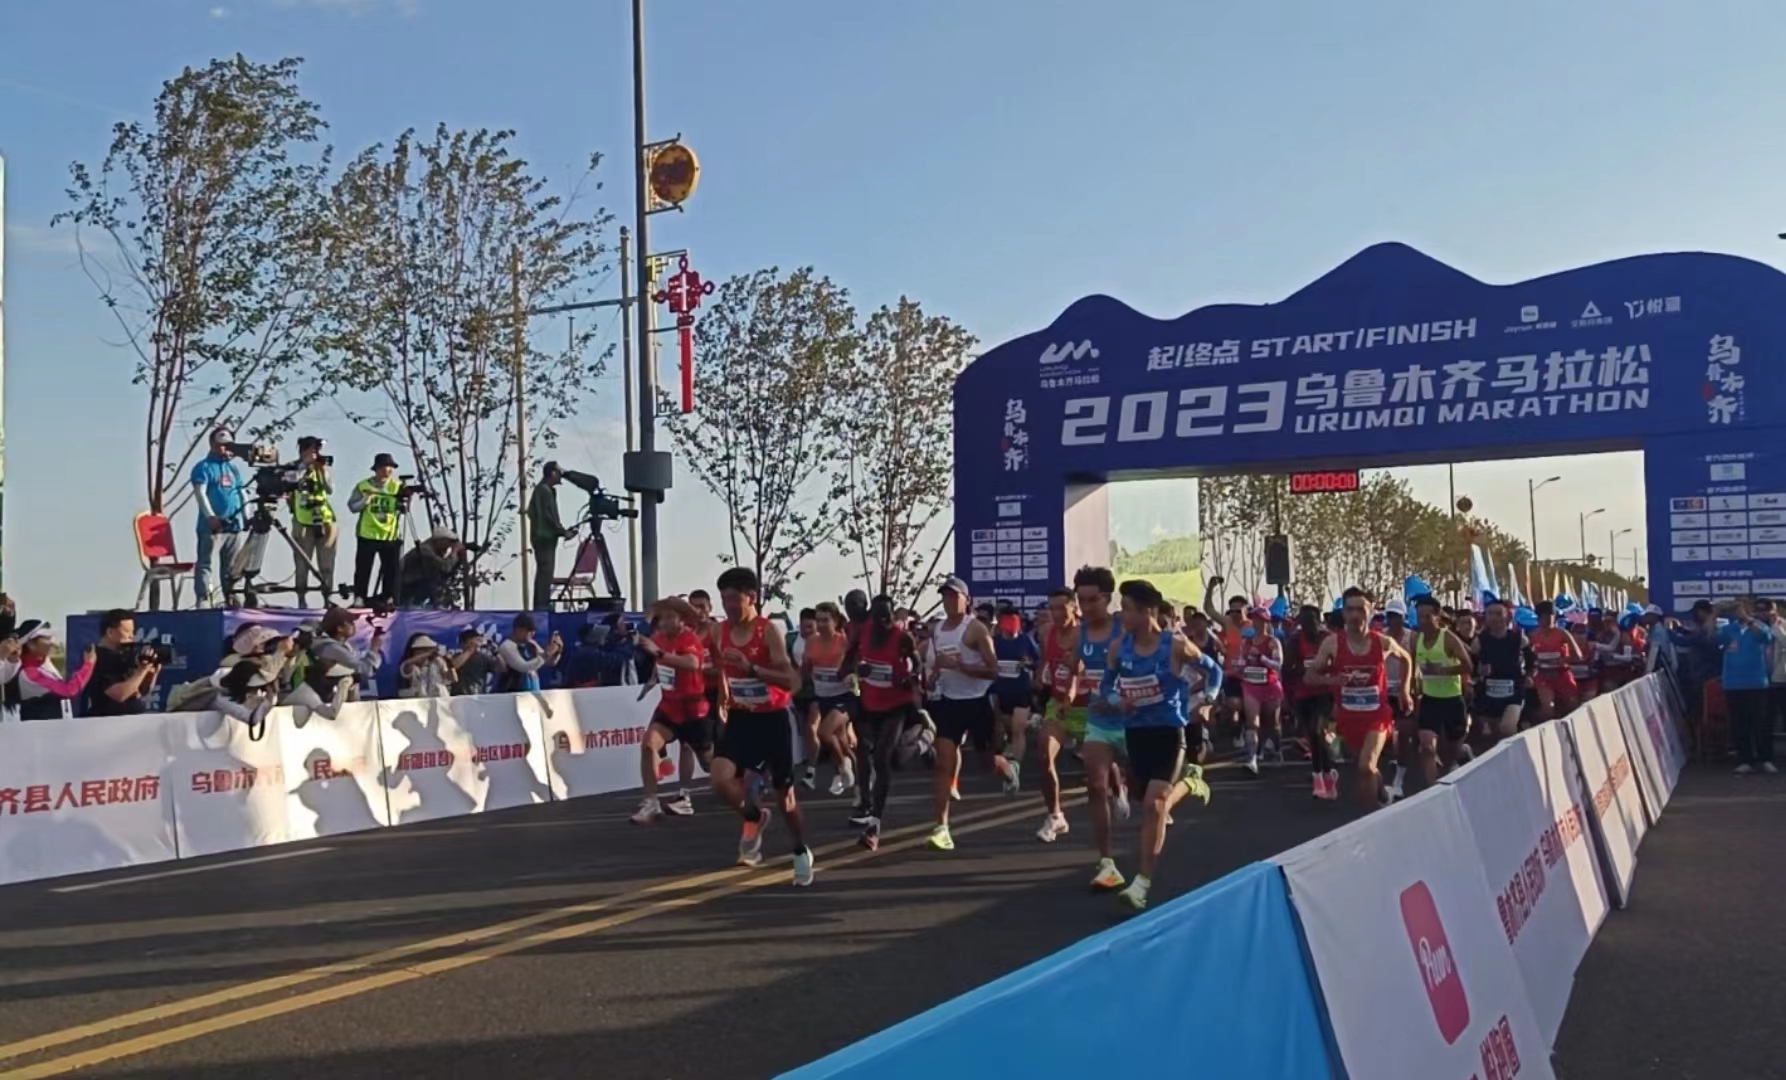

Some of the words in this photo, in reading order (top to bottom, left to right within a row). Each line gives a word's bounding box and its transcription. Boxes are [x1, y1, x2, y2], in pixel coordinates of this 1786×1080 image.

[1147, 340, 1240, 371] 起/终点
[1251, 317, 1477, 358] START/FINISH
[1295, 344, 1651, 410] 乌鲁木齐马拉松
[1061, 381, 1287, 446] 2023
[1295, 406, 1425, 434] URUMQI
[1438, 388, 1650, 424] MARATHON
